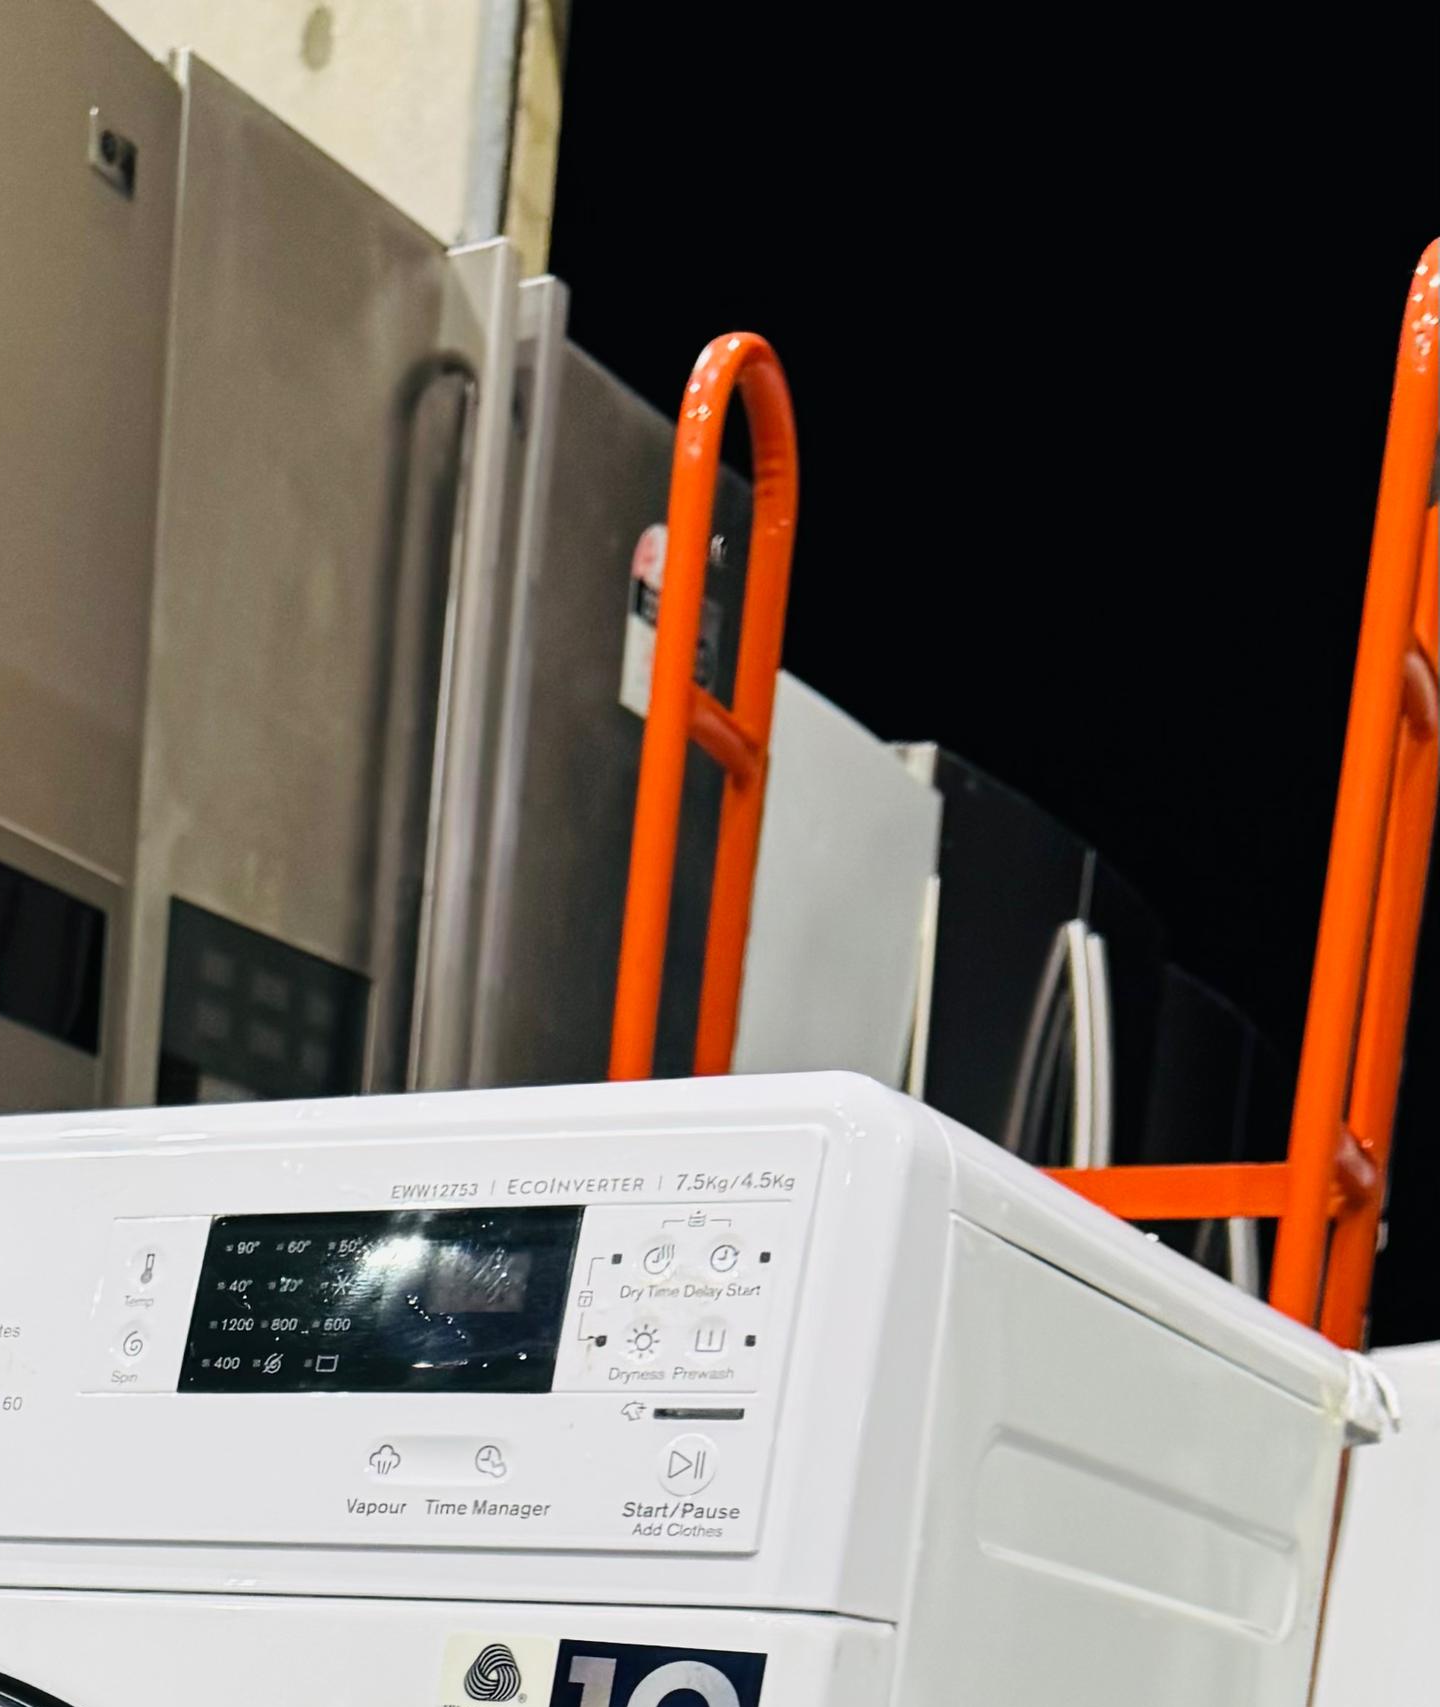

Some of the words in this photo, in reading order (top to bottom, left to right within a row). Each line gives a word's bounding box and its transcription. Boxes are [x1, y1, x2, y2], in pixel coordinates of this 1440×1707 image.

[392, 1183, 479, 1199] EWW12753
[620, 1284, 644, 1300] Dry
[648, 1284, 680, 1298] Time
[684, 1284, 722, 1300] Delay
[726, 1284, 761, 1298] Start
[221, 1319, 254, 1331] 1200
[270, 1318, 298, 1331] 800
[214, 1357, 240, 1370] 400
[111, 1370, 138, 1384] Spin
[609, 1367, 665, 1383] Dryness
[673, 1366, 734, 1380] Prewash
[2, 1396, 23, 1411] 60
[347, 1499, 407, 1517] Vapour
[425, 1500, 468, 1516] Time
[472, 1501, 550, 1519] Manager
[622, 1501, 740, 1520] Start/Pause
[632, 1523, 662, 1537] Add
[667, 1523, 723, 1538] Clothes
